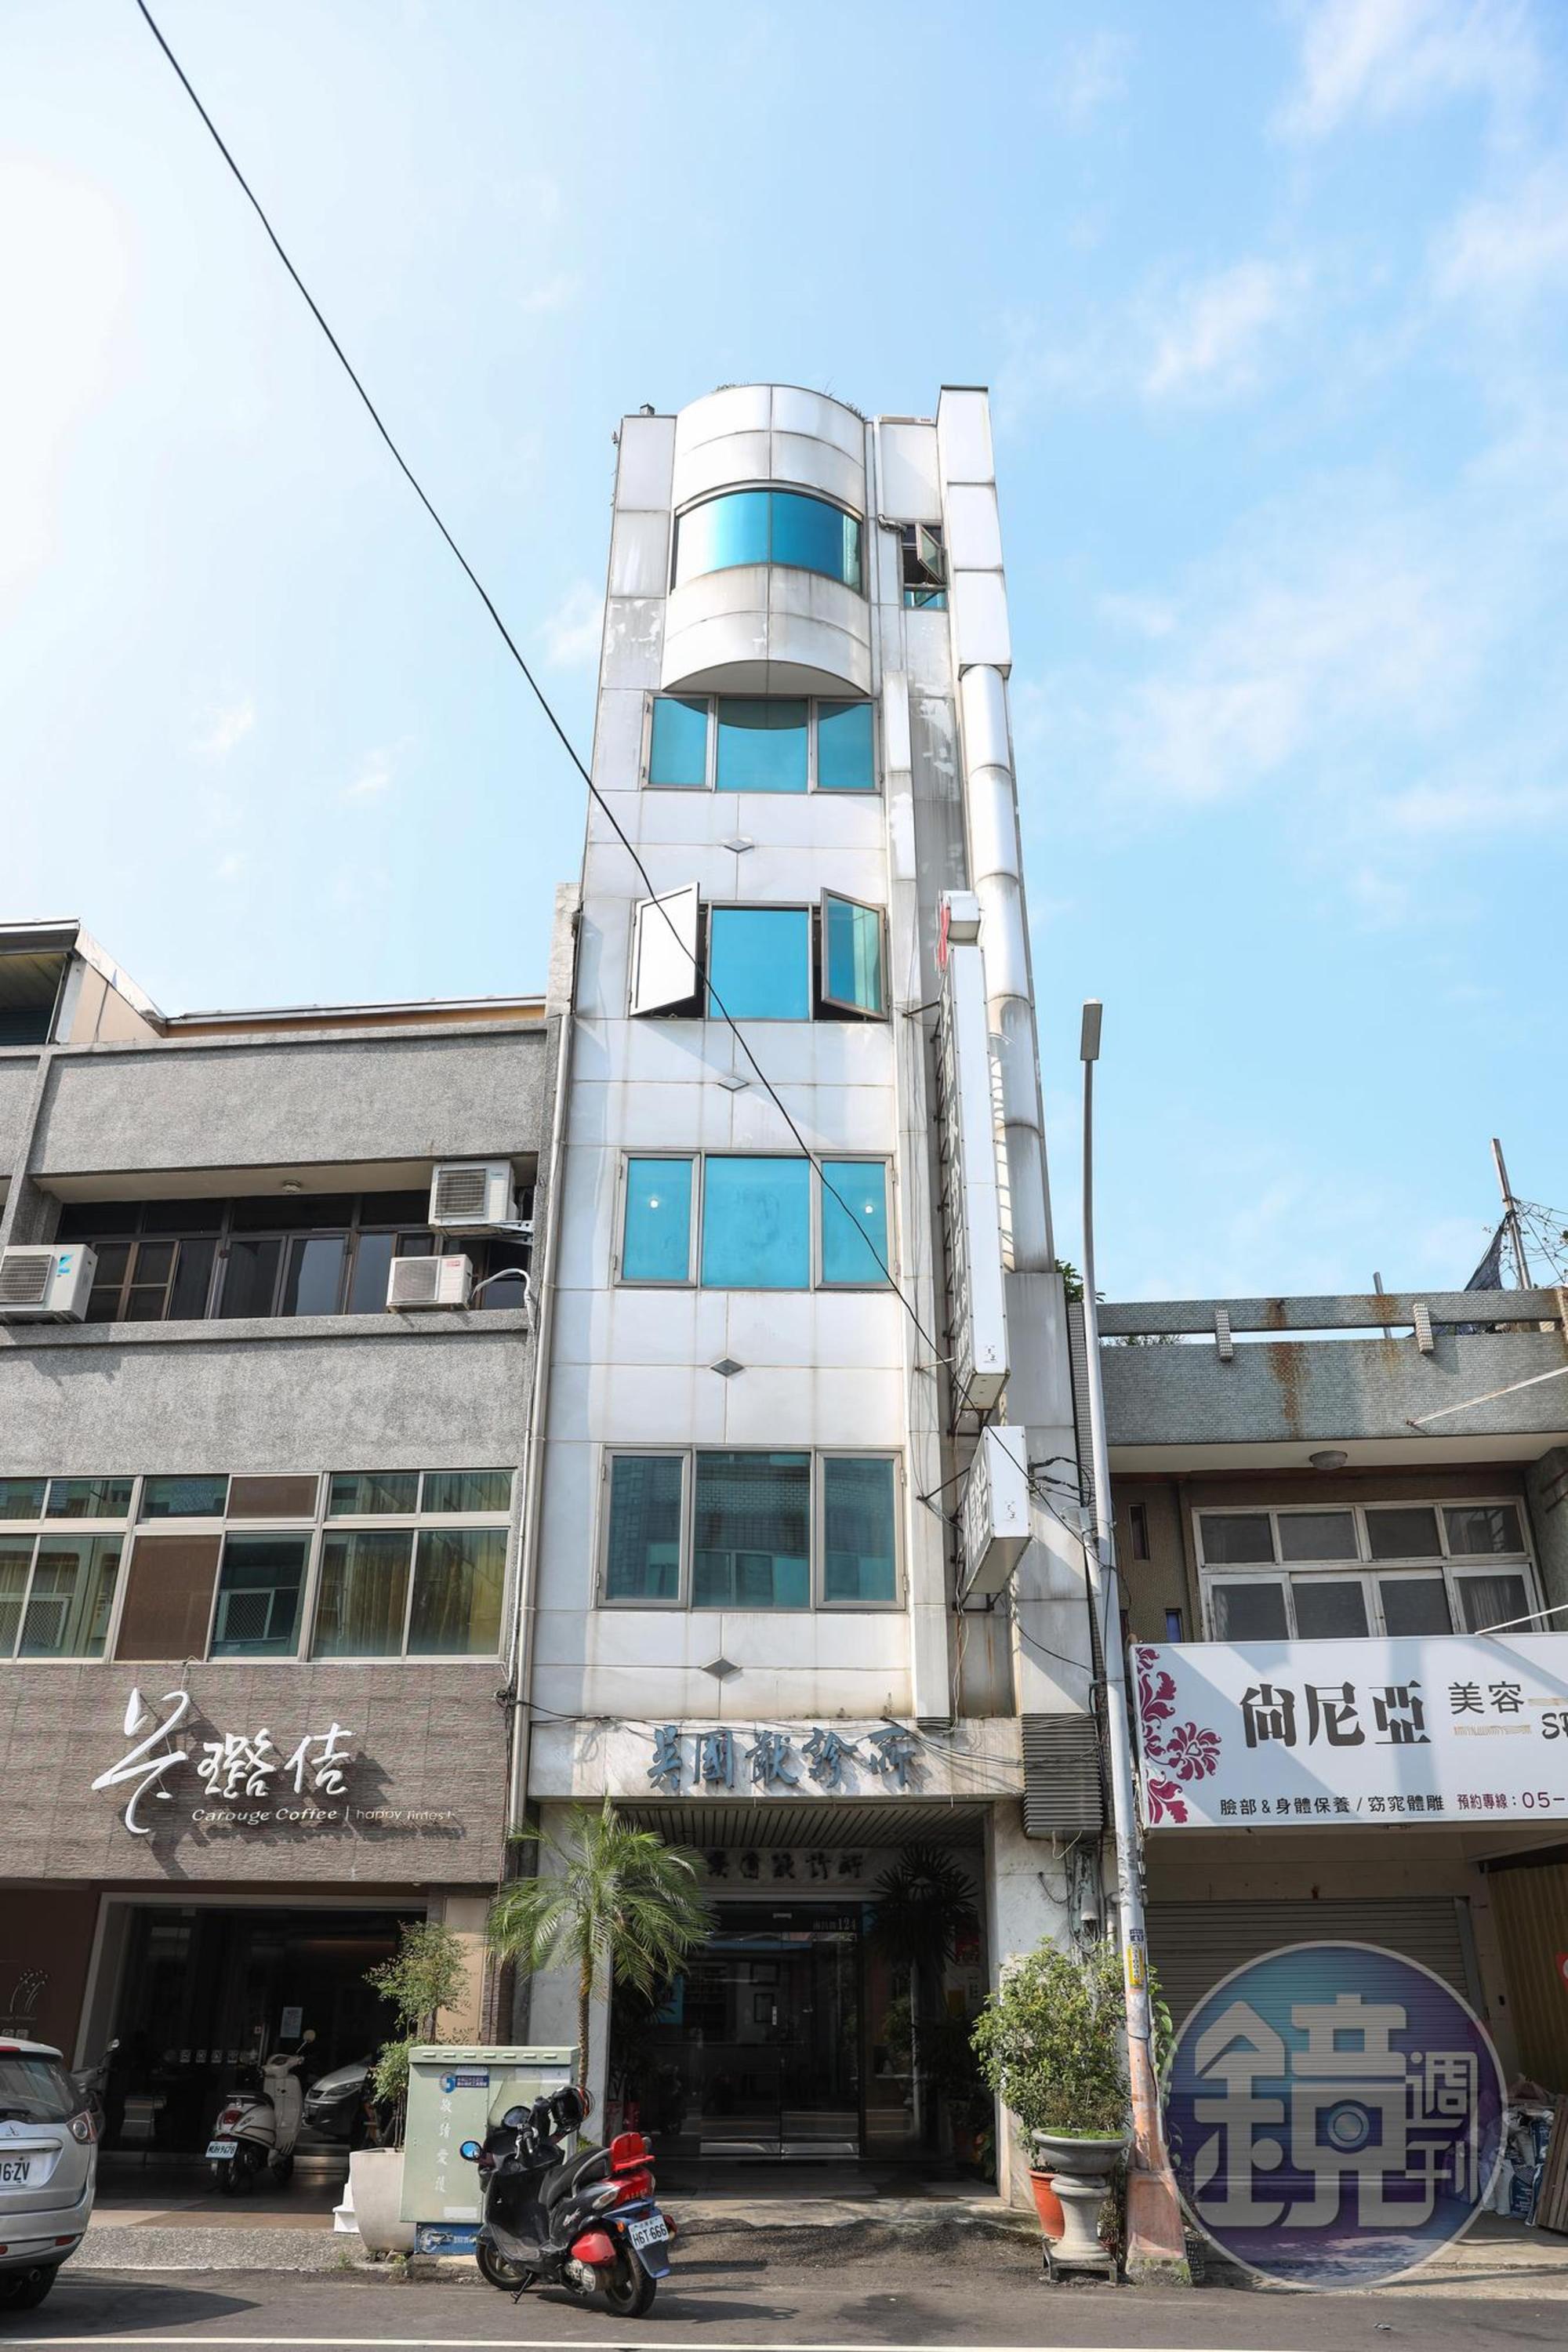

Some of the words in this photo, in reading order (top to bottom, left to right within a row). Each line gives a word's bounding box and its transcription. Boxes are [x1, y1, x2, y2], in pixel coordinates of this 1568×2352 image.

[1240, 1680, 1432, 1748] 尚尼亞
[1446, 1681, 1525, 1715] 美容
[191, 1809, 270, 1826] Carouge
[275, 1806, 338, 1821] Coffee
[356, 1809, 402, 1821] happy
